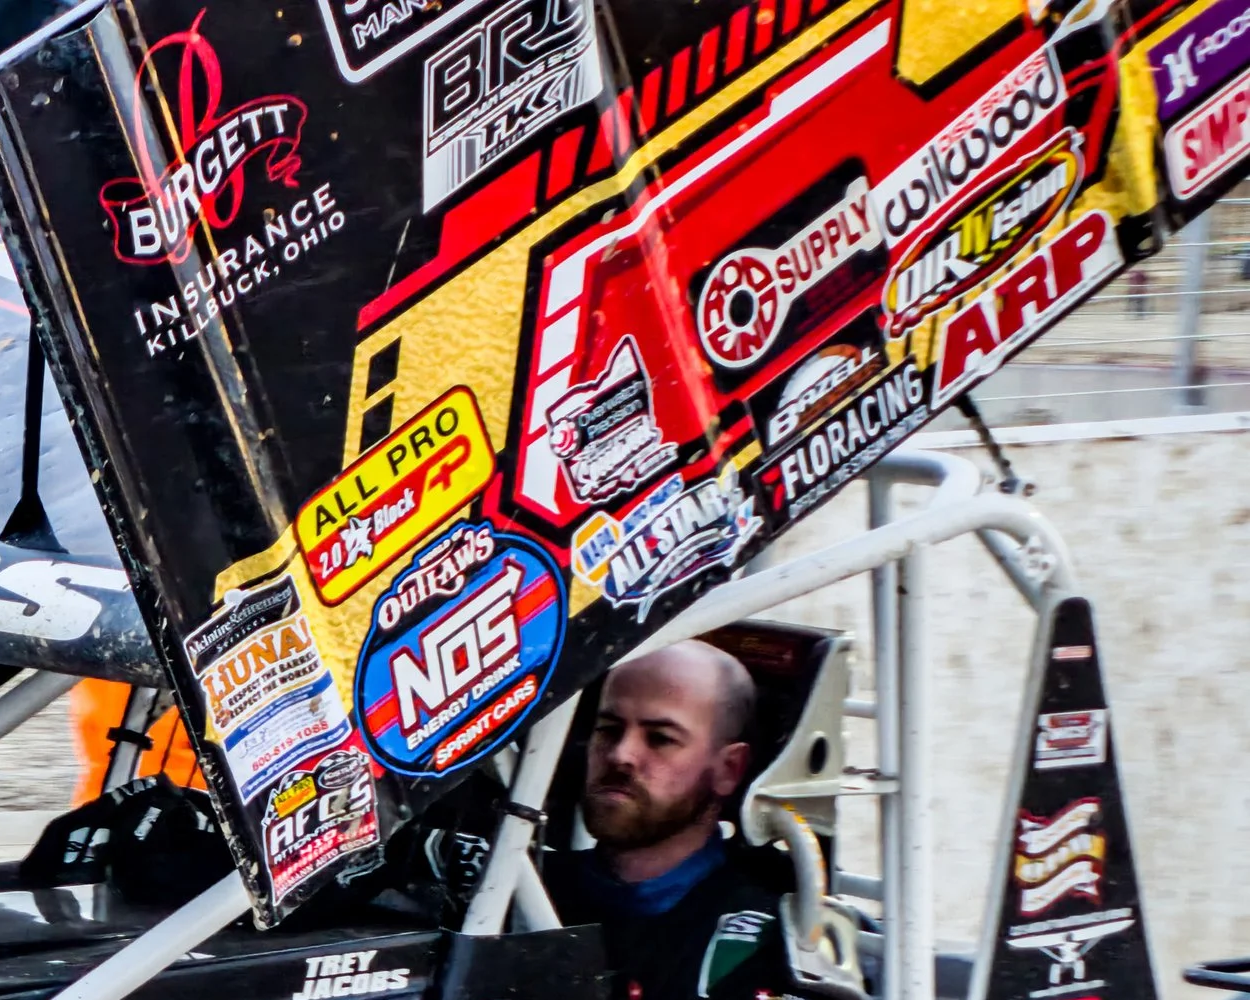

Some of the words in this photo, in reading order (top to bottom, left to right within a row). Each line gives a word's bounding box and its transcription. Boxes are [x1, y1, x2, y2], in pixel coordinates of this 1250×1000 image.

[129, 103, 289, 256] BURGETT
[885, 60, 1059, 237] wilwood
[134, 182, 336, 335] INSURANCE
[146, 260, 281, 358] KILLBUCK,
[283, 210, 345, 262] OHIO
[775, 194, 871, 294] SUPPLY
[938, 212, 1107, 391] ARP
[315, 475, 380, 537] ALL
[386, 406, 459, 477] PRO
[780, 363, 924, 500] FLORACING
[377, 527, 495, 630] OUTLAWS
[203, 615, 312, 700] LiUNA!
[227, 676, 262, 706] RESPECT
[261, 667, 277, 683] THE
[229, 691, 262, 719] RESPECT
[262, 680, 279, 696] THE
[392, 563, 524, 731] NOS
[406, 694, 470, 751] ENERGY
[472, 652, 522, 700] DRINK
[436, 710, 494, 765] SPRINT
[492, 679, 537, 720] CARS
[305, 949, 379, 978] TREY
